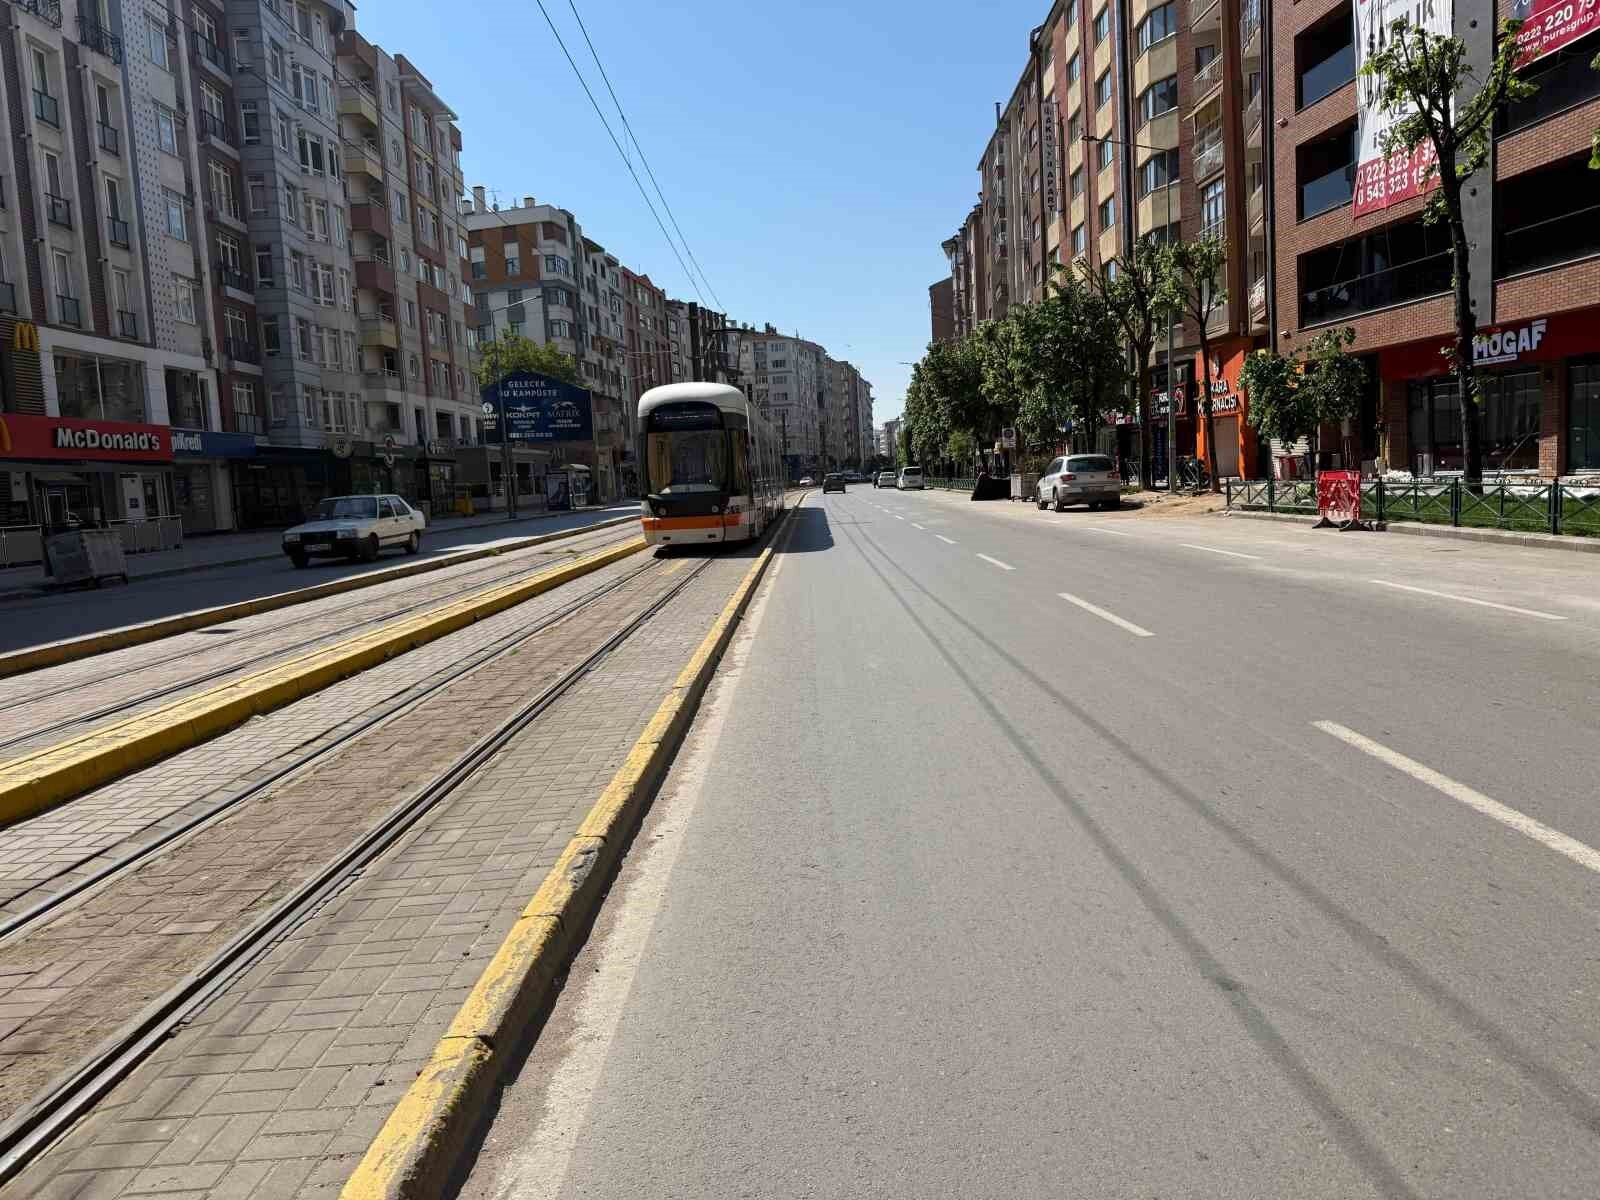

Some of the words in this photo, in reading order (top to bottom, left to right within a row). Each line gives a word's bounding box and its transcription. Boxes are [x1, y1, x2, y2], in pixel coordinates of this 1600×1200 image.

[1545, 4, 1573, 31] 220
[1366, 181, 1386, 203] 543
[1388, 171, 1408, 196] 323
[57, 427, 160, 450] McDonald's
